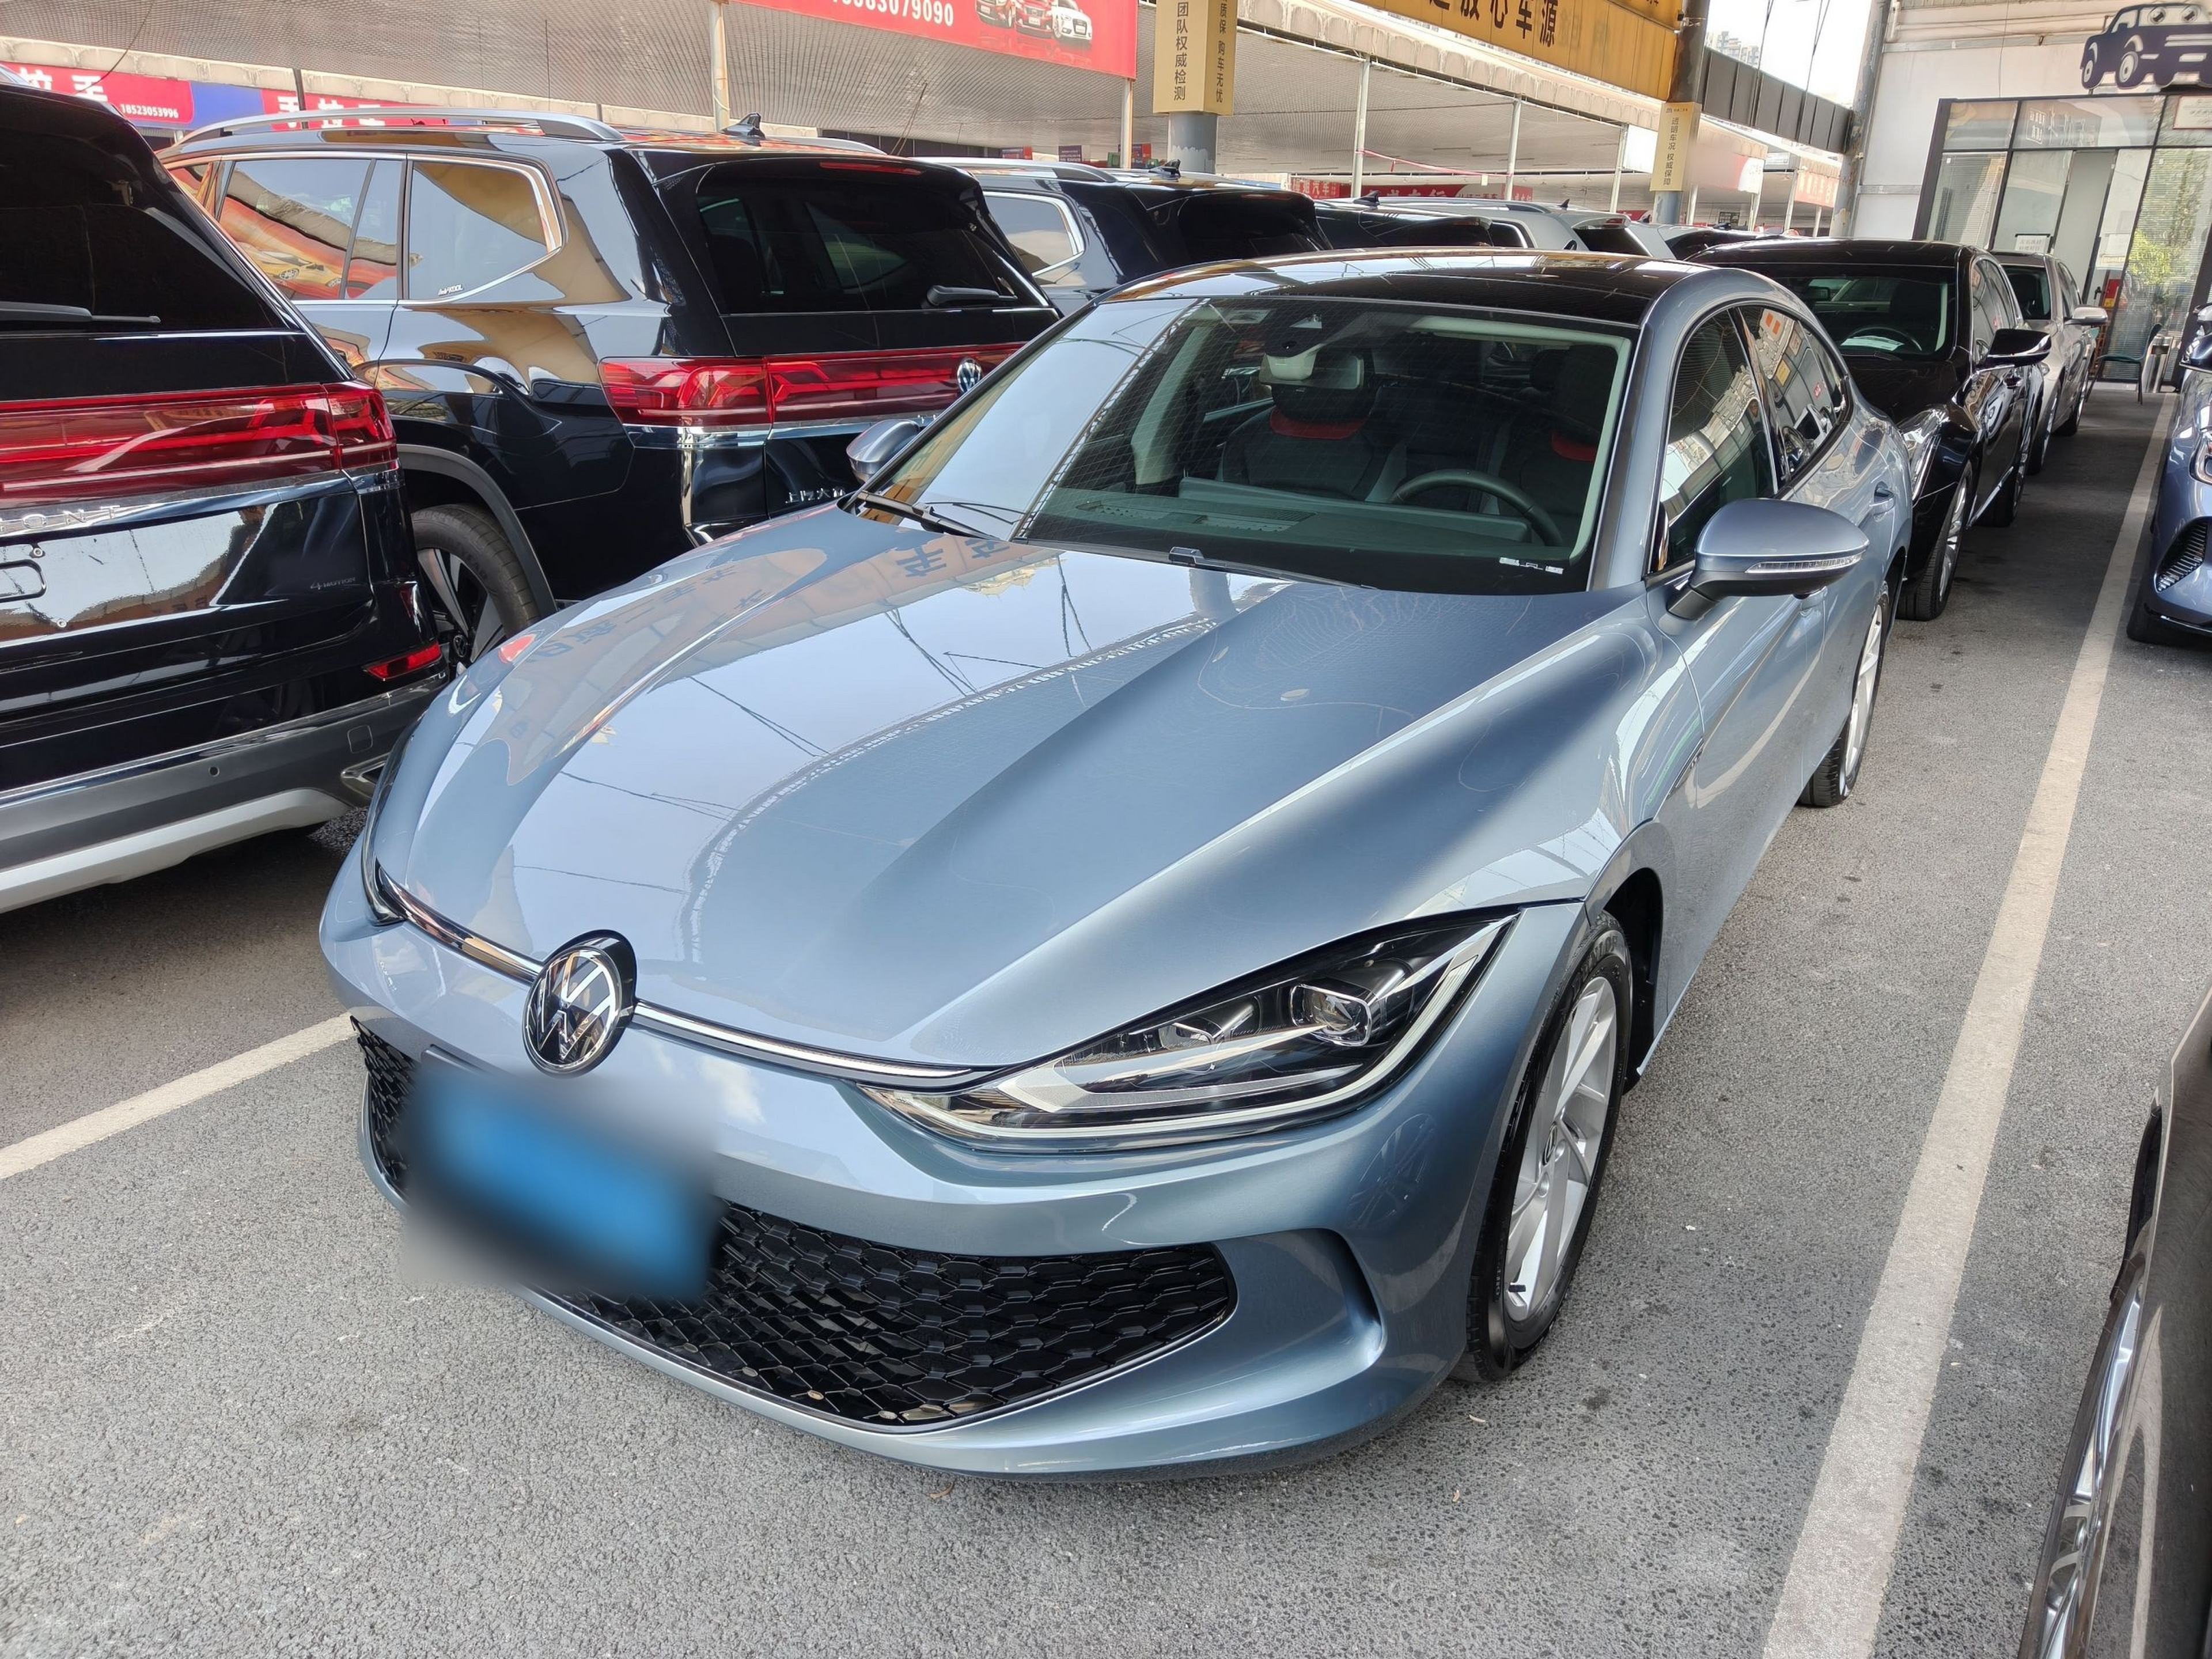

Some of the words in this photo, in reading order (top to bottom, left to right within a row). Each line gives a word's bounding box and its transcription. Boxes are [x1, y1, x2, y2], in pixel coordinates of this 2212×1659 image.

[833, 0, 954, 26] 3079090
[1219, 0, 1228, 34] 质保
[1430, 0, 1556, 48] 心车源
[1173, 2, 1188, 101] 团队权威检测
[120, 104, 179, 119] 18523053996
[0, 504, 120, 533] ONT
